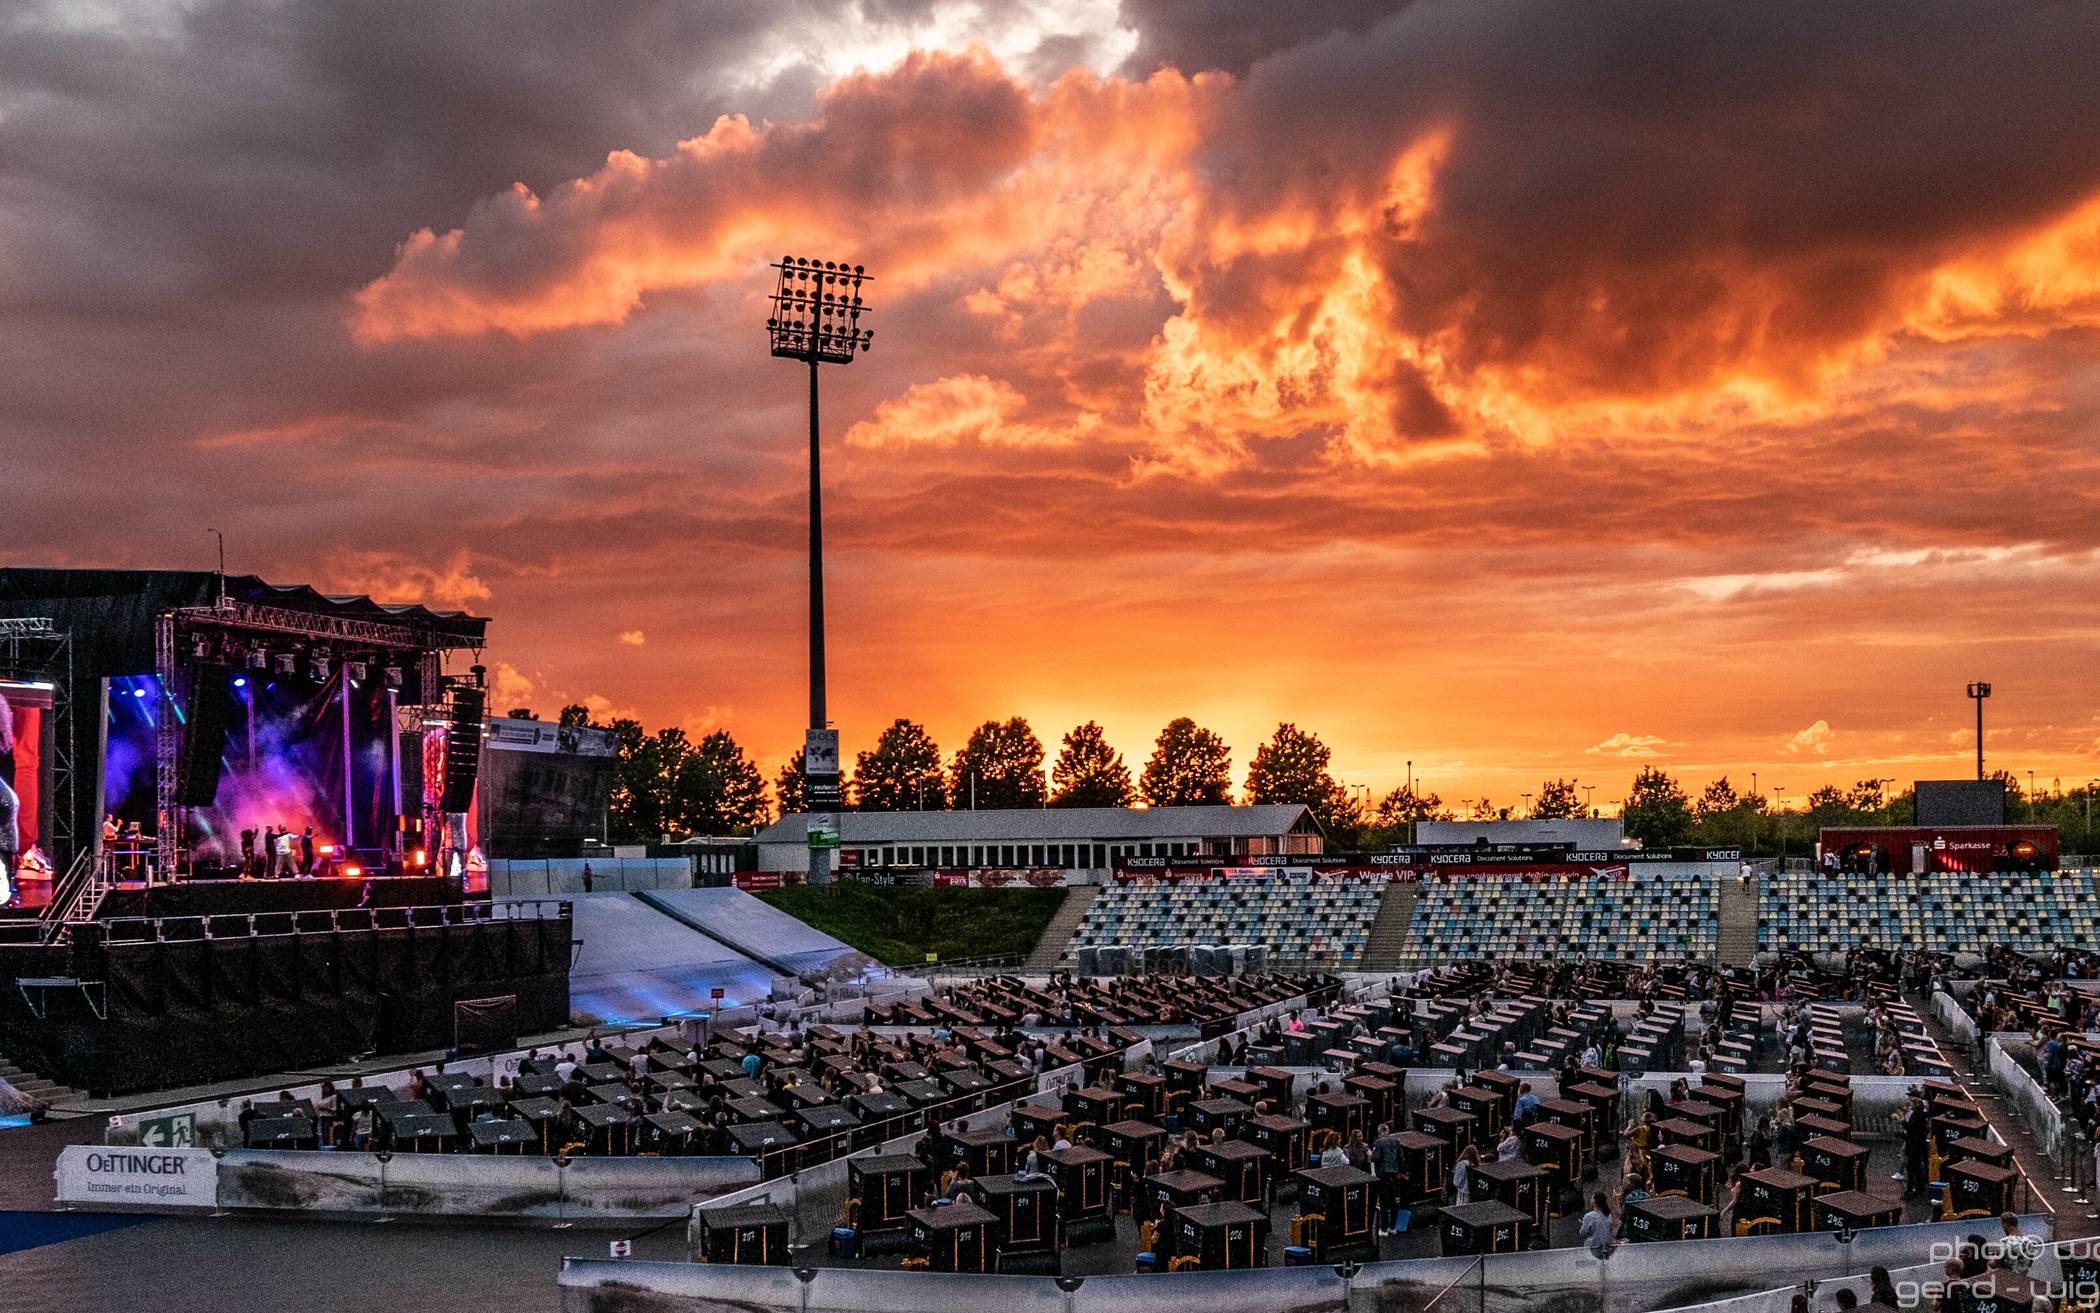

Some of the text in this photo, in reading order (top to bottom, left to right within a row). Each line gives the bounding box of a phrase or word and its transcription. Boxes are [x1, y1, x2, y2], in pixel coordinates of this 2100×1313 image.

[1949, 842, 1991, 851] Sparkasse
[1248, 856, 1287, 865] KYOCERA
[1371, 855, 1410, 864] KYOCERA
[1430, 854, 1471, 863] KYOCERA
[1566, 852, 1607, 861] KYOCERA
[1127, 857, 1165, 867] KYOCERA
[1171, 858, 1199, 866] Document
[855, 872, 895, 885] Fan-Style
[1359, 870, 1394, 880] Werde
[1664, 1162, 1681, 1174] 237
[88, 1182, 123, 1193] Immer
[125, 1183, 142, 1193] ein
[1307, 1185, 1321, 1197] 225
[1962, 1179, 1981, 1193] 250
[1632, 1216, 1650, 1231] 238
